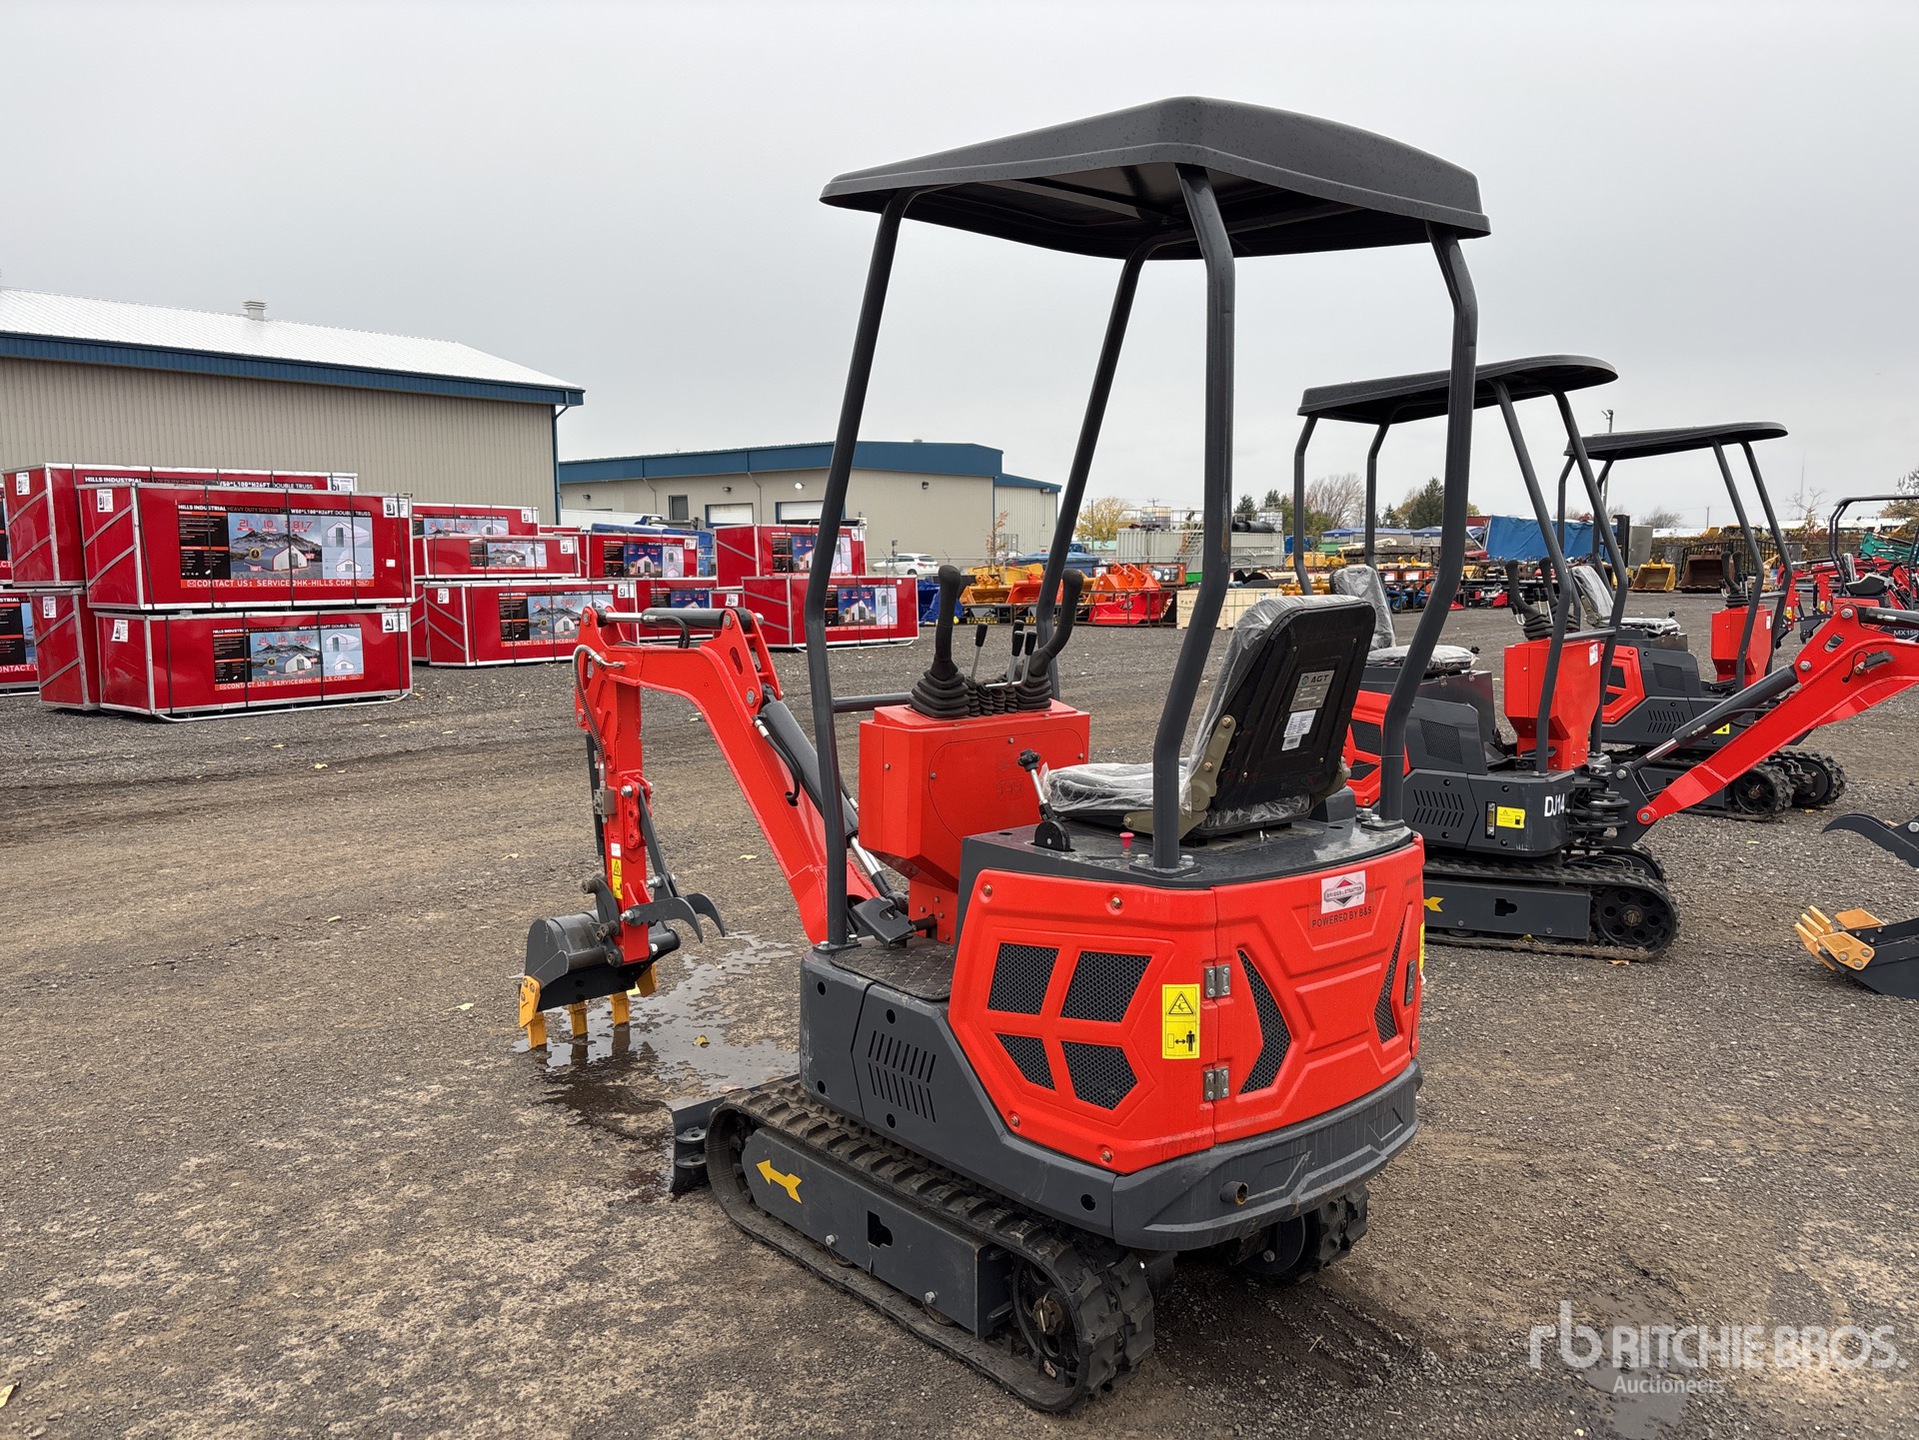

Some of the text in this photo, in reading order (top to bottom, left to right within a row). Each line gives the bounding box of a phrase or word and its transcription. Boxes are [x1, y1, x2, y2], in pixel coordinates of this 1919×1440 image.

[1311, 675, 1329, 683] AGT
[1544, 793, 1565, 817] DJ14
[1312, 906, 1372, 927] POWERED BY B&S
